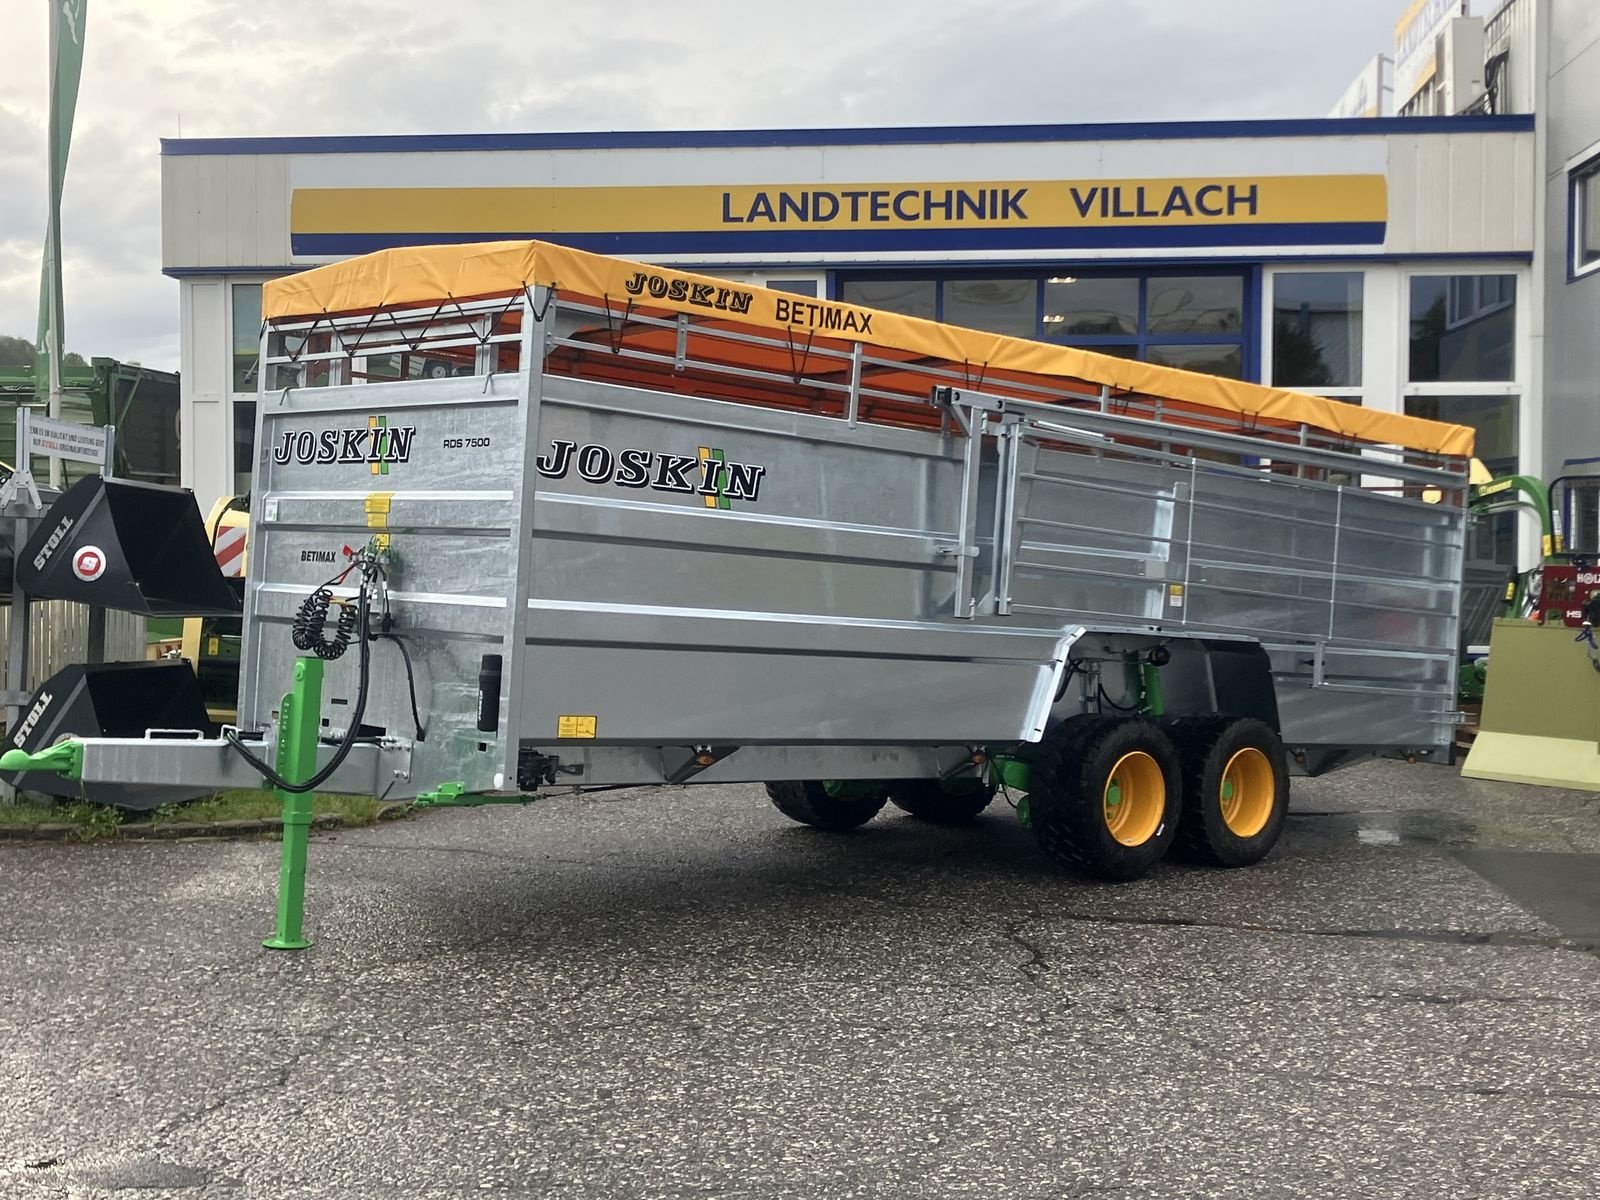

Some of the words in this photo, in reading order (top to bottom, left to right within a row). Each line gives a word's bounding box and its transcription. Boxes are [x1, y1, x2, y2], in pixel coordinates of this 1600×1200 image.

[722, 188, 1028, 223] LANDTECHNIK
[1070, 184, 1258, 219] VILLACH
[625, 272, 753, 314] JOSKIN
[775, 298, 873, 335] BETIMAX
[274, 425, 416, 465] JOSKIN
[443, 439, 463, 449] RDS
[465, 437, 490, 448] 7500
[536, 439, 766, 501] JOSKIN
[33, 515, 74, 571] STOLL
[300, 550, 336, 563] BETIMAX
[1576, 572, 1600, 584] HOL
[13, 691, 53, 748] STOLL
